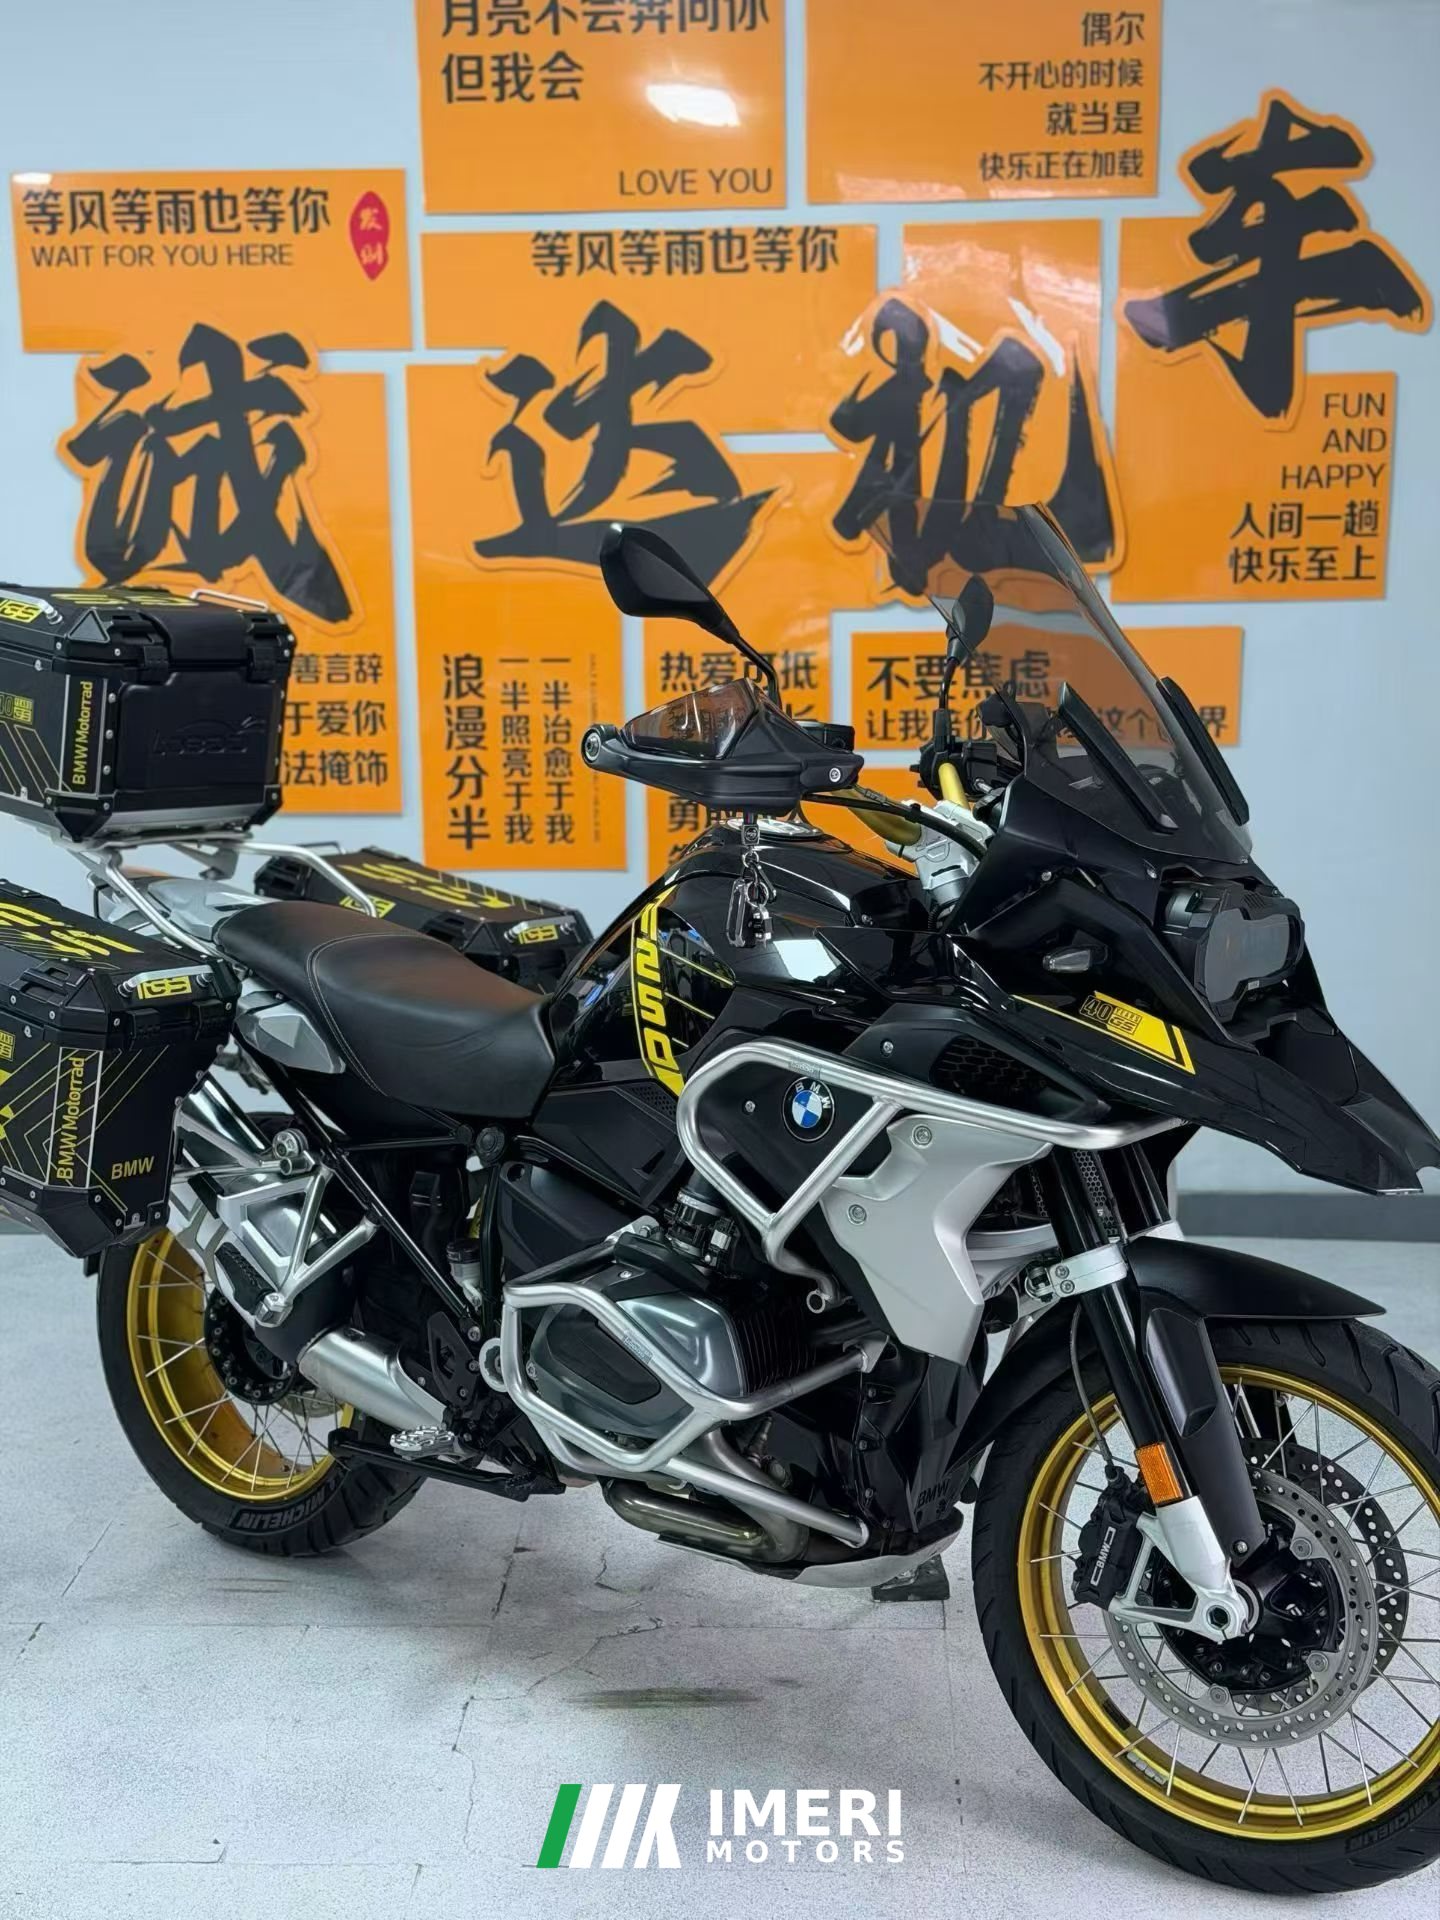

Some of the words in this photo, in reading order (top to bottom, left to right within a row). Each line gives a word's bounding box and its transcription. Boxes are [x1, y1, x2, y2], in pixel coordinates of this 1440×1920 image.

[443, 0, 770, 37] 月亮不会奔向你
[1083, 12, 1145, 47] 偶尔
[442, 51, 584, 104] 但我会
[980, 59, 1144, 91] 不开心的时候
[1047, 101, 1143, 137] 就当是
[620, 170, 696, 197] LOVE
[708, 168, 773, 195] YOU
[980, 149, 1144, 182] 快乐正在加载
[24, 188, 331, 236] 等风等雨也等你
[32, 245, 94, 268] WAIT
[104, 245, 156, 268] FOR
[162, 246, 220, 268] YOU
[226, 244, 293, 267] HERE
[532, 228, 839, 278] 等风等雨也等你
[1324, 393, 1386, 418] FUN
[1322, 428, 1388, 454] AND
[1282, 464, 1385, 490] HAPPY
[1231, 500, 1380, 541] 人间一趟
[1229, 545, 1378, 585] 快乐至上
[867, 650, 1051, 702] 不要焦虑
[78, 681, 94, 743] Motorrad
[72, 743, 87, 786] BMW
[283, 751, 389, 787] 法掩饰
[443, 653, 491, 851] 浪漫分半
[499, 658, 534, 845] 一半照亮于我
[541, 657, 575, 845] 一半治愈于我
[1083, 998, 1114, 1021] 40
[64, 1056, 86, 1131] Motorrad
[56, 1135, 78, 1181] BMW
[111, 1156, 155, 1180] BMW
[1095, 1541, 1111, 1569] BMW
